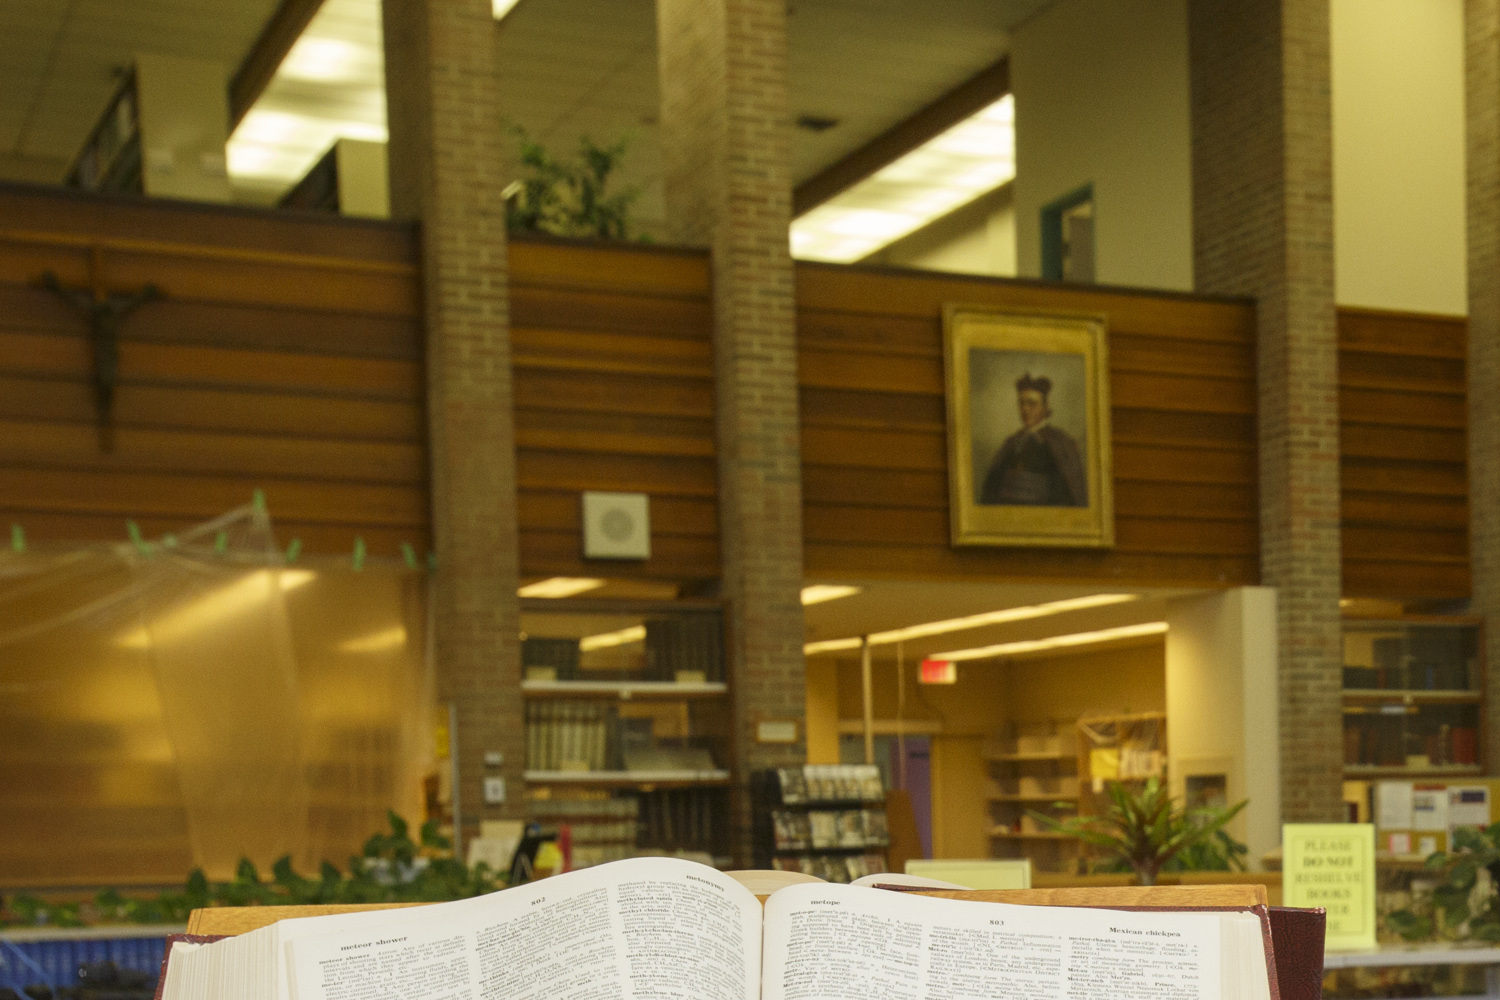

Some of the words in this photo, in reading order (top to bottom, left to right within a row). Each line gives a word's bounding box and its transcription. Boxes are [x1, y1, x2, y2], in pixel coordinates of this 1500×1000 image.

[1304, 840, 1351, 851] PLEASE
[1303, 857, 1323, 867] DO
[1326, 856, 1353, 867] NOT
[686, 874, 725, 892] metonymy
[1295, 872, 1361, 883] RESHELVE
[1306, 889, 1351, 898] BOOKS
[531, 896, 546, 906] 802
[810, 899, 841, 907] metope
[1109, 927, 1143, 936] Mexican
[1145, 930, 1181, 938] chickpea
[340, 942, 373, 951] meteor
[376, 936, 408, 946] shower
